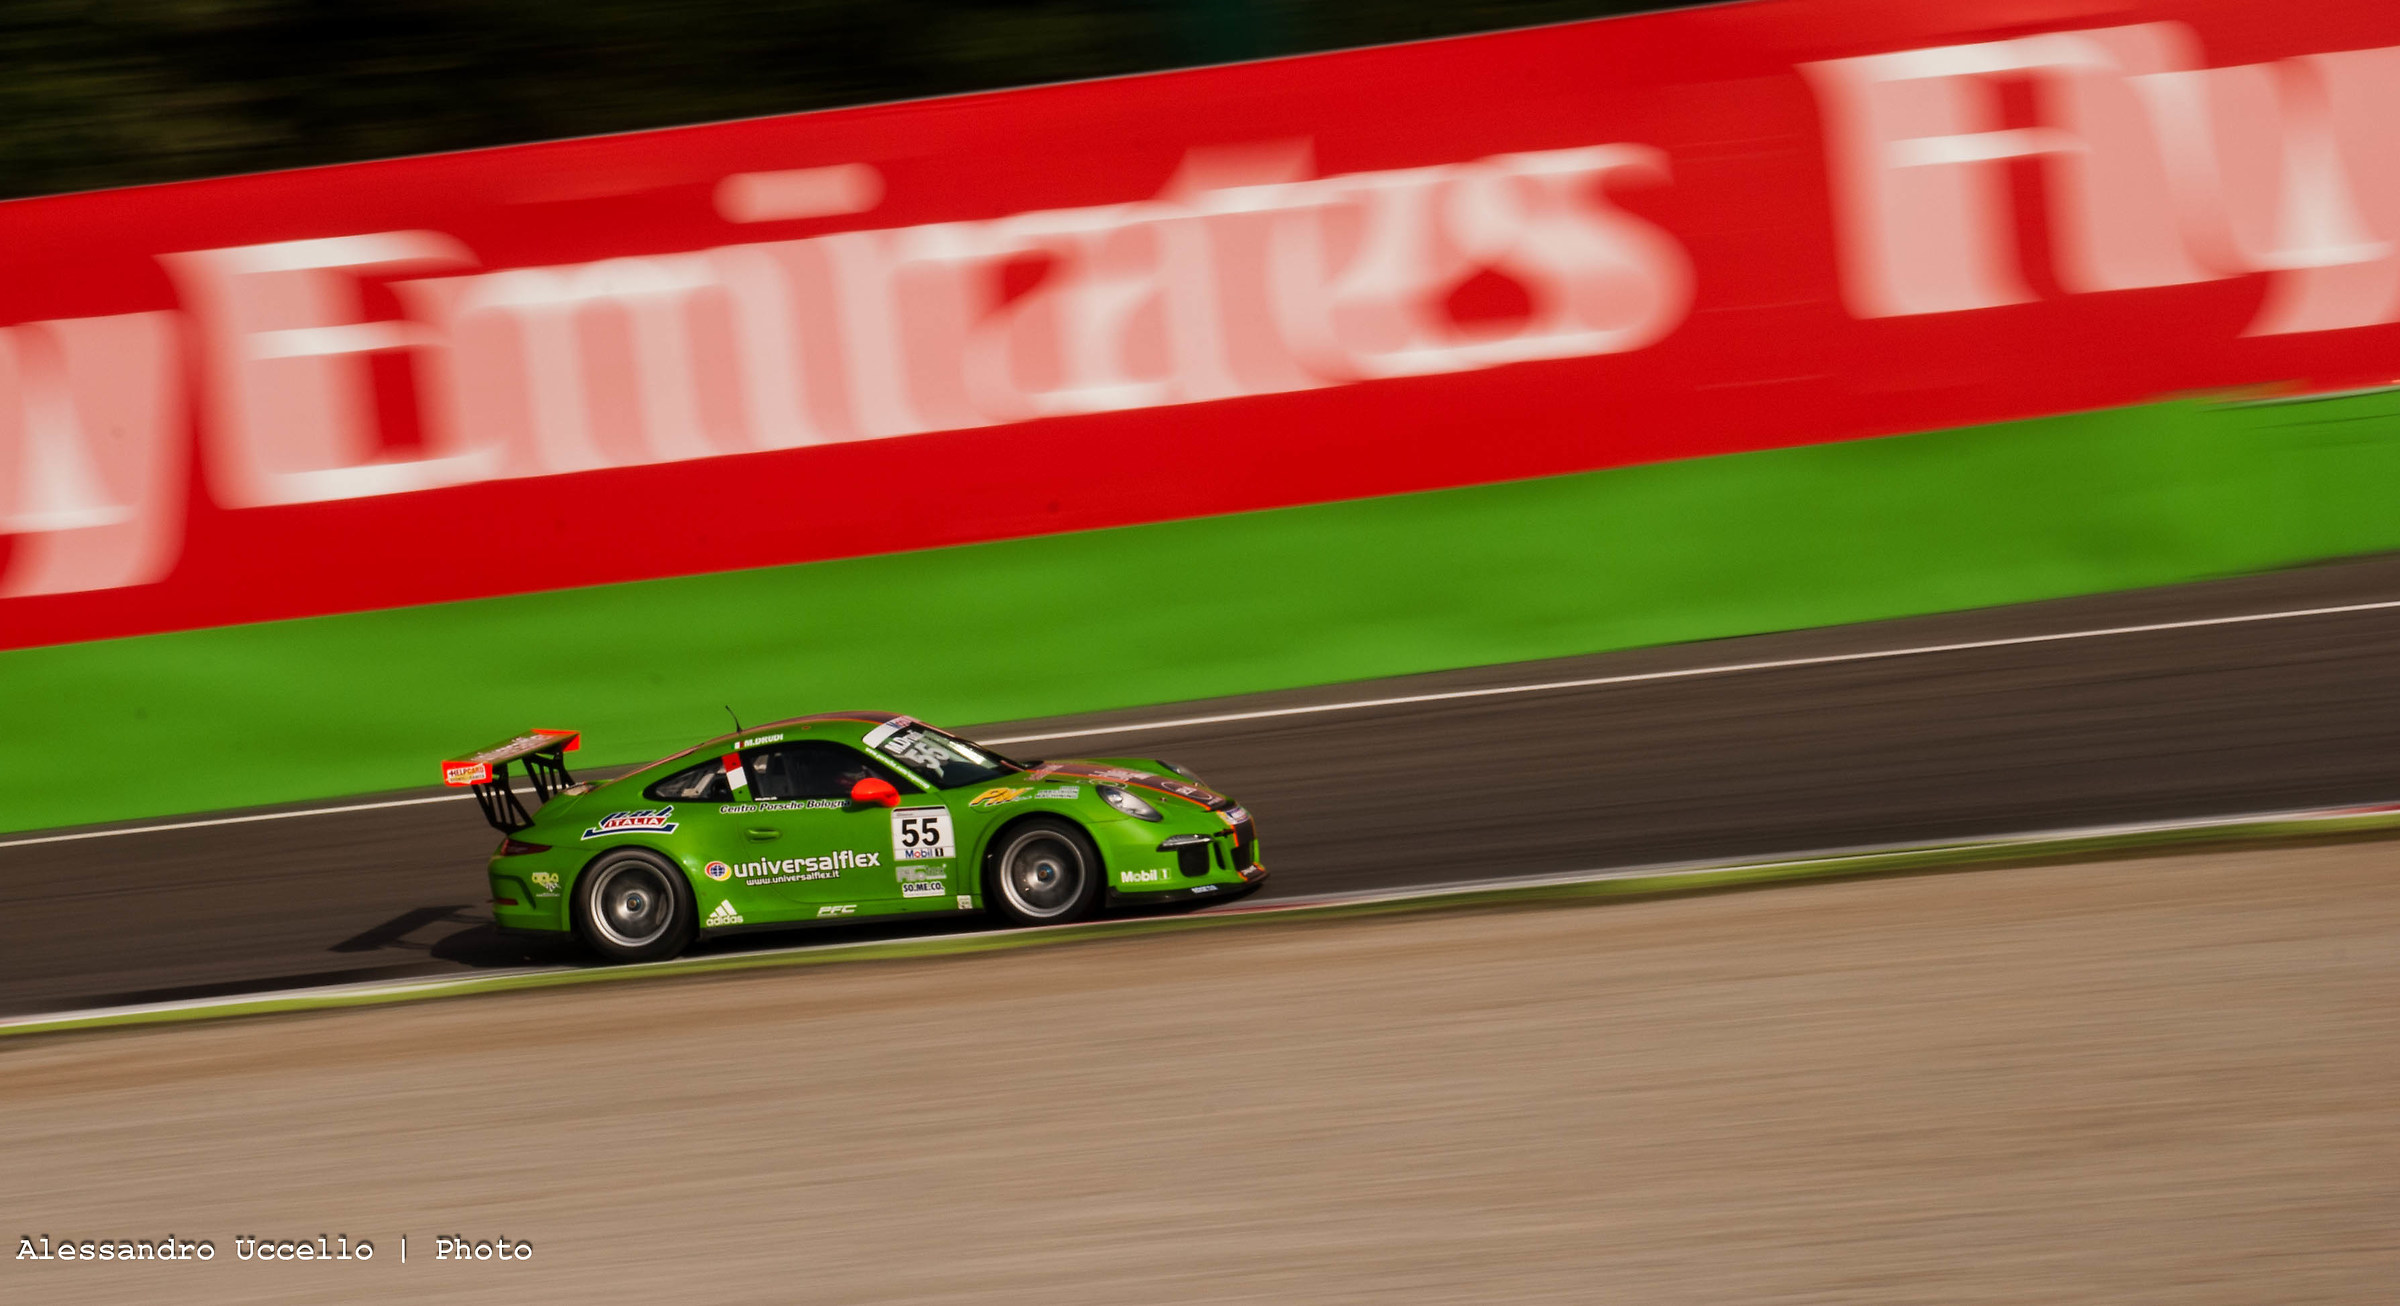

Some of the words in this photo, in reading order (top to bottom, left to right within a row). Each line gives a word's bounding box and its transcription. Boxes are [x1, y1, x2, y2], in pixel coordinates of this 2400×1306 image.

[155, 138, 1697, 509] Emirates
[744, 734, 784, 747] M.DRUDI
[719, 804, 756, 814] Centro
[759, 801, 803, 811] Porsche
[806, 799, 850, 809] Bologna
[609, 817, 659, 827] ITALIA
[902, 818, 940, 847] 55
[905, 849, 933, 858] Mobil
[734, 850, 880, 878] universalflex
[746, 870, 840, 886] www.universalflex.it
[1121, 869, 1158, 883] Mobil
[903, 882, 944, 892] SO.ME.CO.
[817, 904, 858, 917] PFC
[706, 914, 744, 927] adidas
